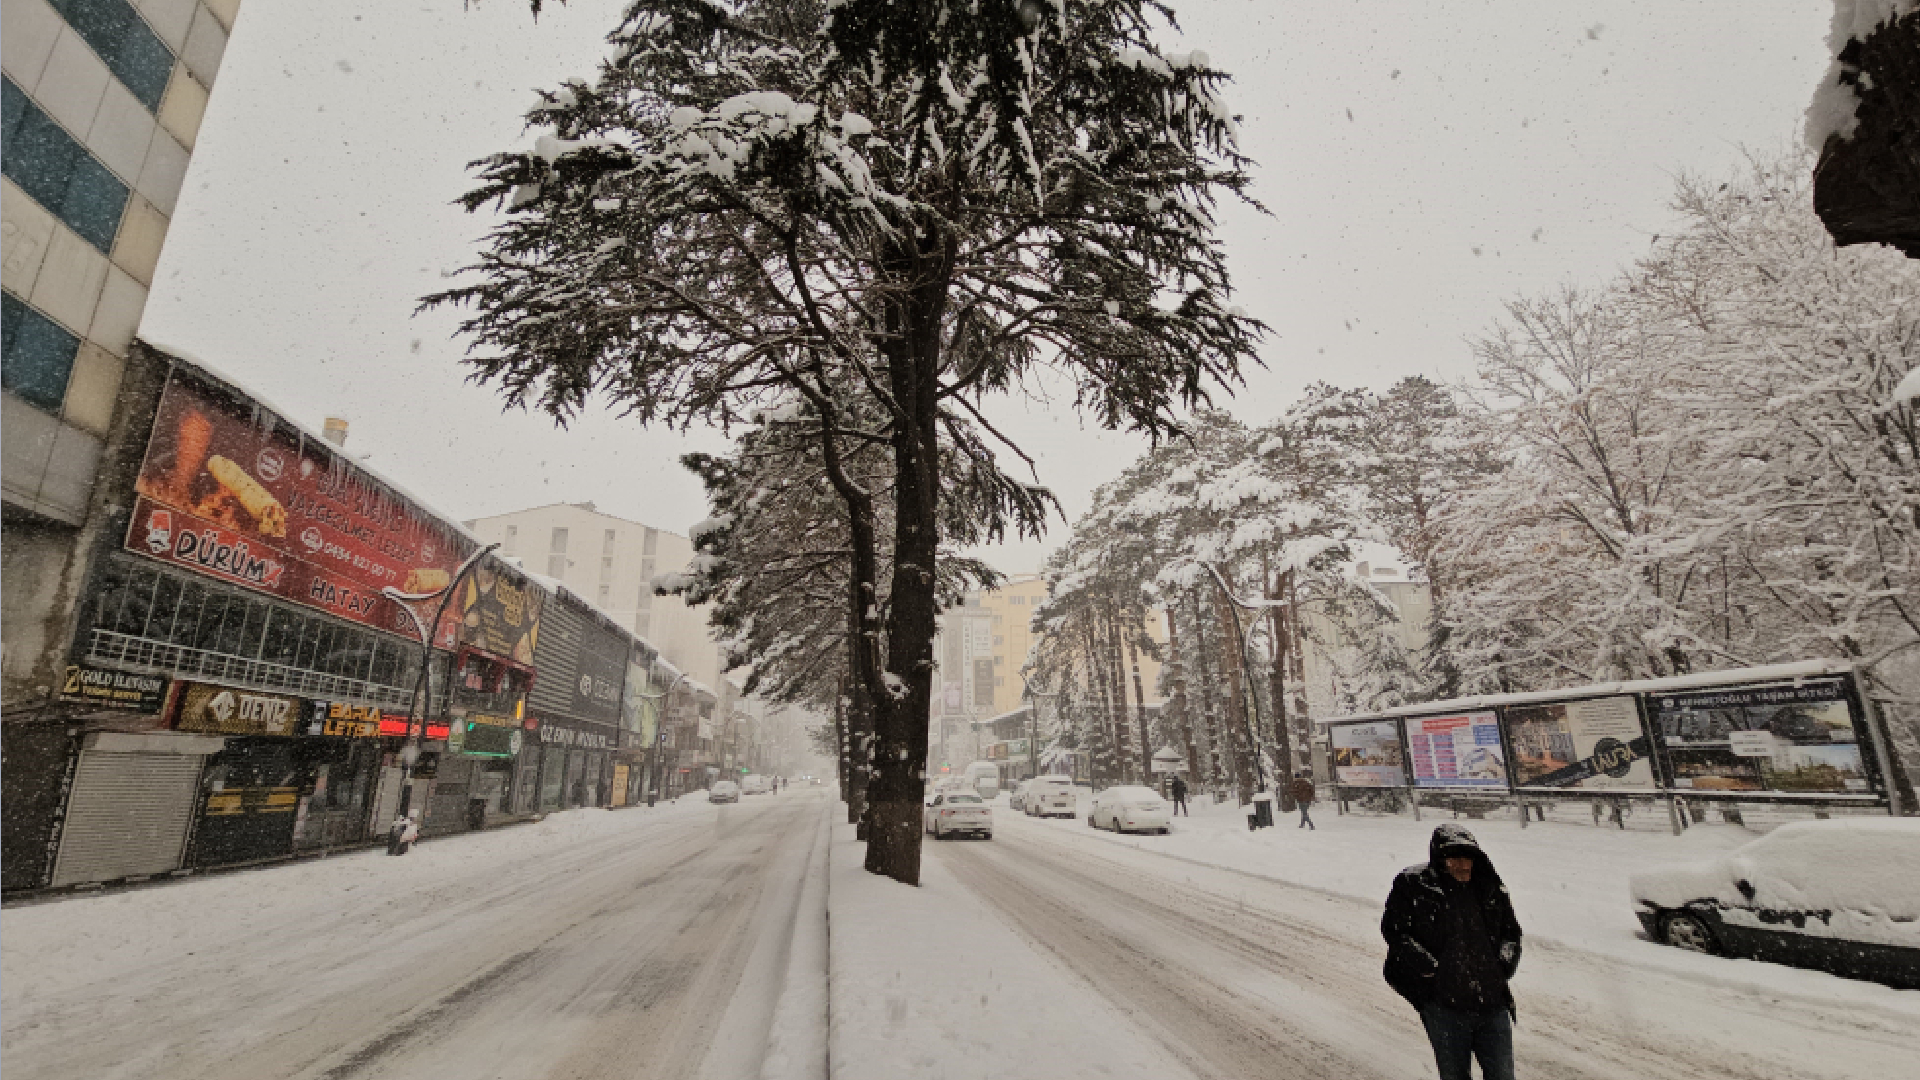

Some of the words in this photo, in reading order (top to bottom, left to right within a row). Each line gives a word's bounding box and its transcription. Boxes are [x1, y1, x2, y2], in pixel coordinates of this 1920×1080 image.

[173, 528, 265, 585] DÜRÜM
[308, 575, 377, 618] HATAY
[80, 669, 112, 685] GOLD
